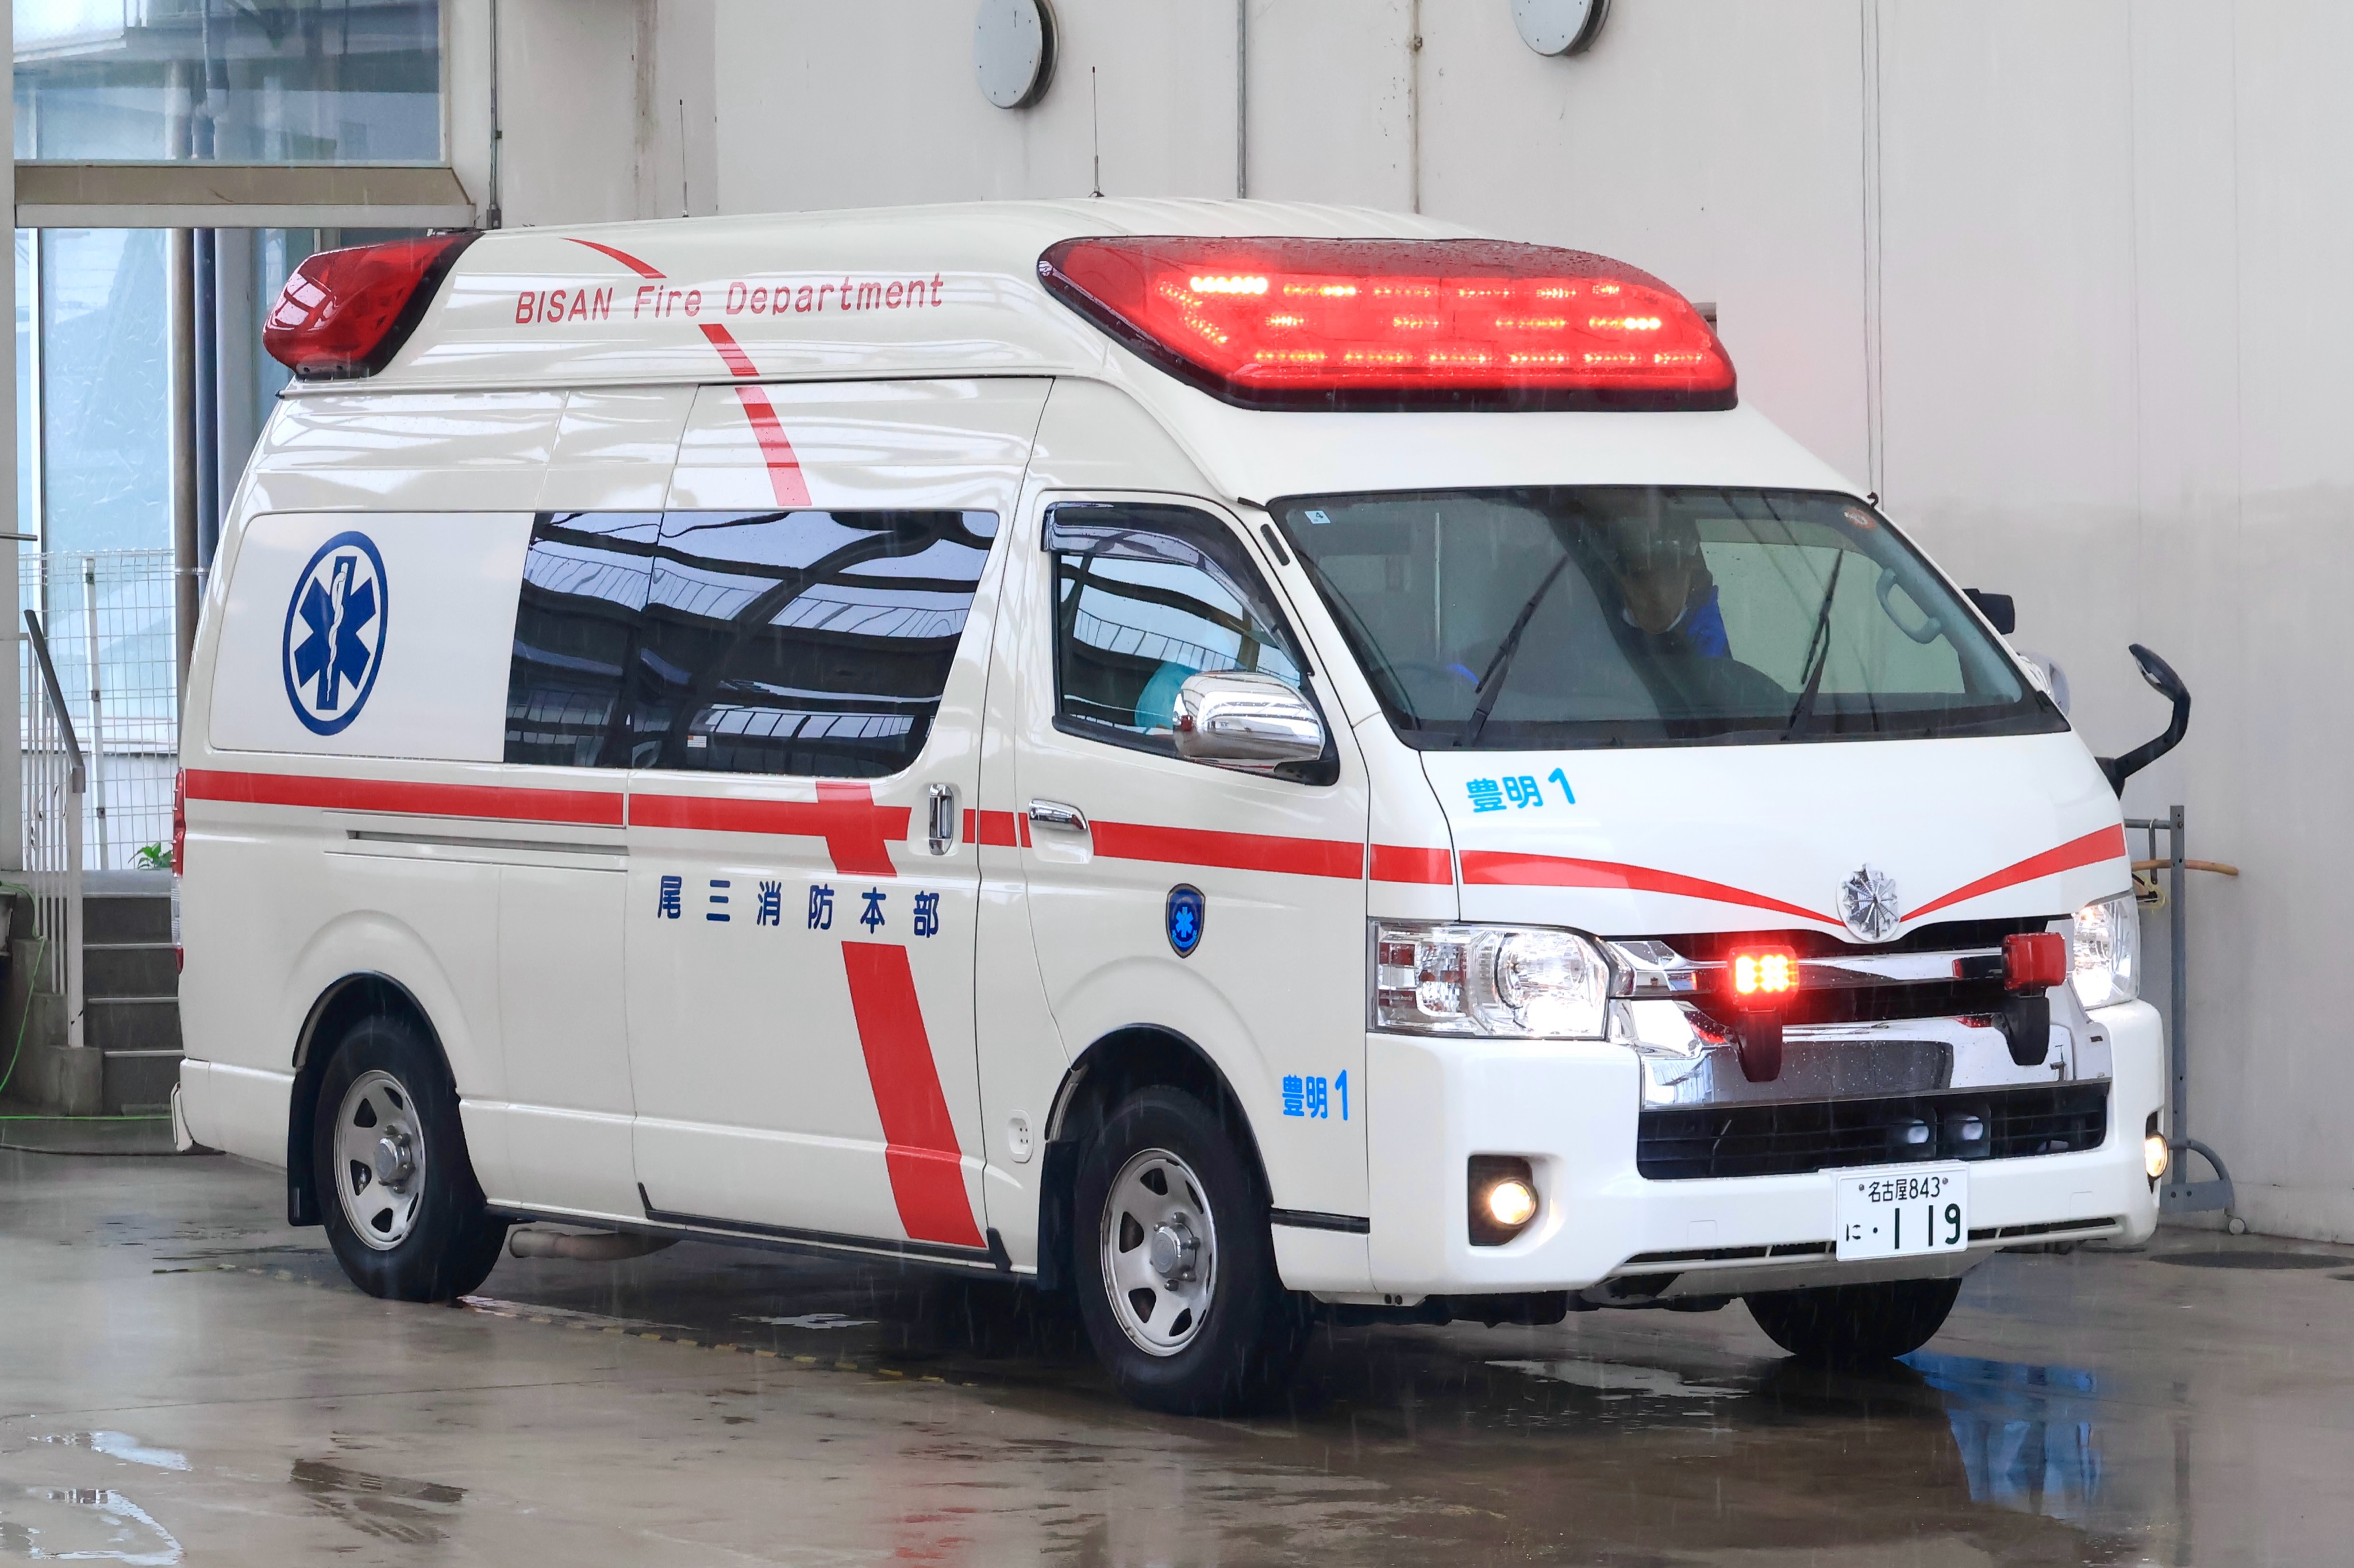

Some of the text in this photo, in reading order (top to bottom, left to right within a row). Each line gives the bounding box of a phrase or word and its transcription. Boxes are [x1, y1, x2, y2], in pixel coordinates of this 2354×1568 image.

[515, 273, 944, 324] BISAN Fire Department
[657, 875, 940, 938] 尾三消防本部
